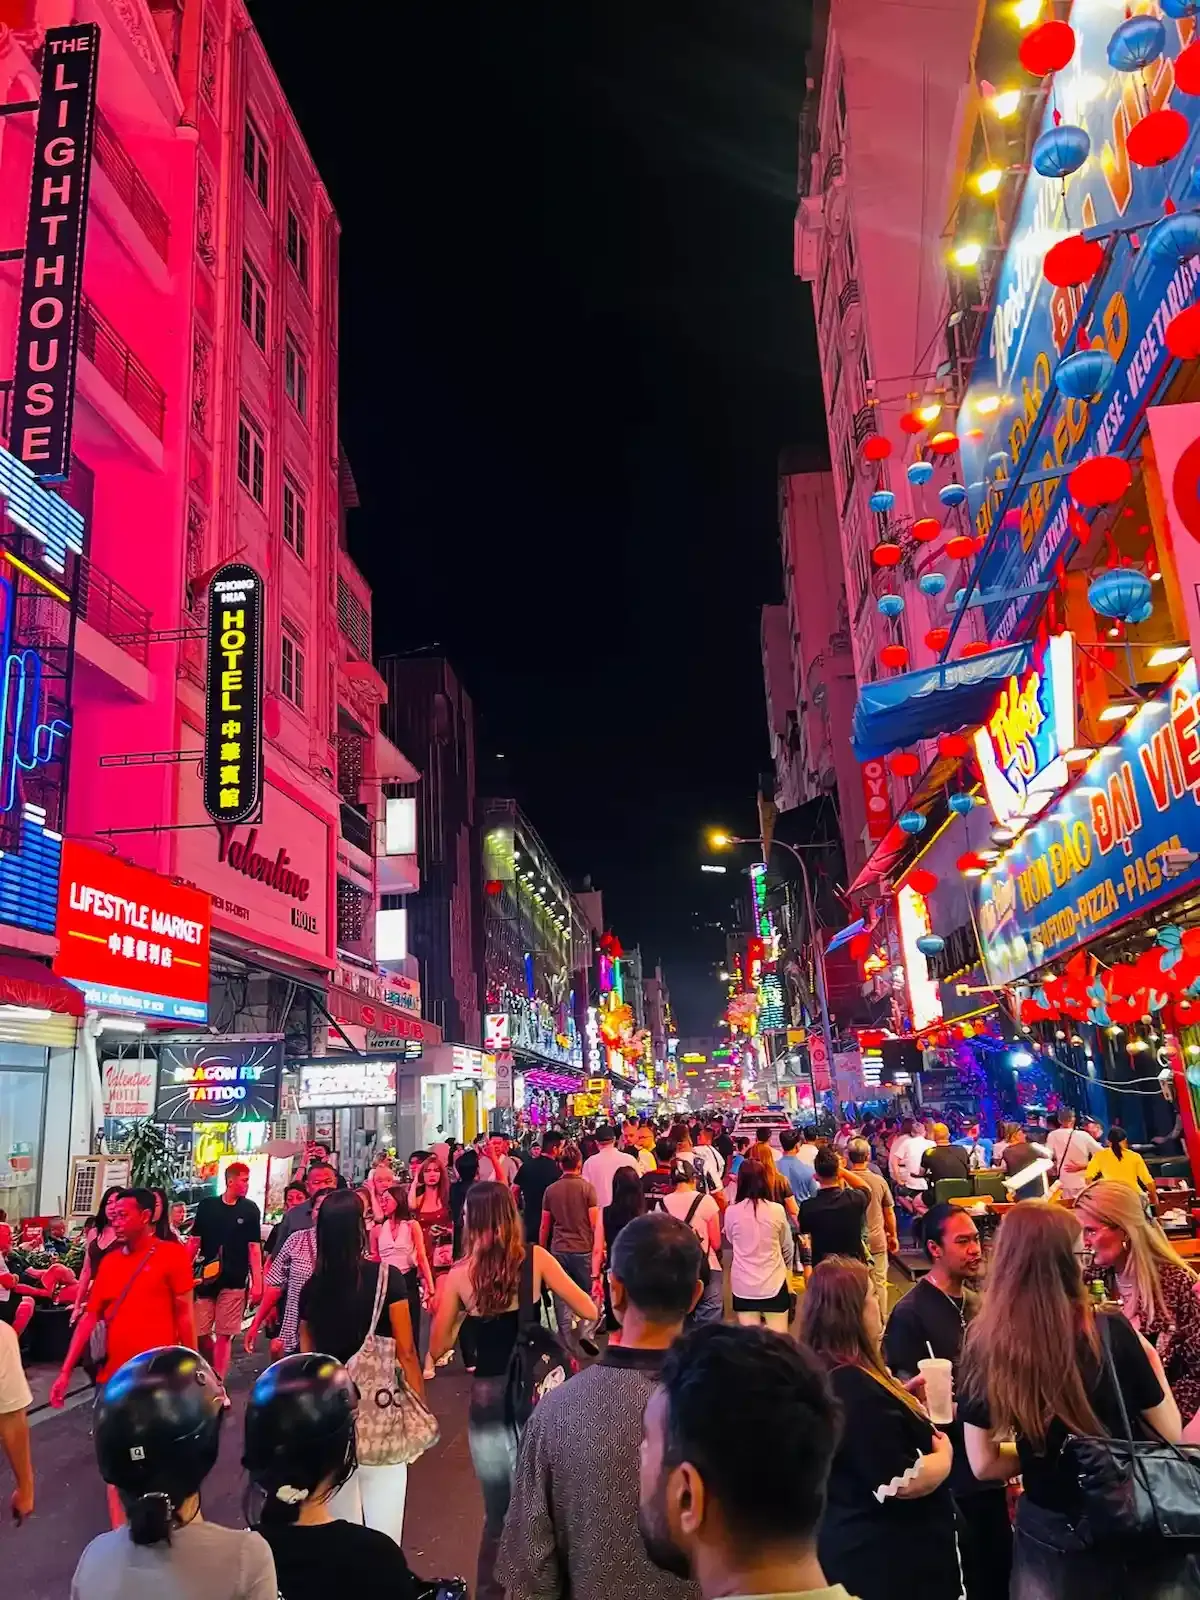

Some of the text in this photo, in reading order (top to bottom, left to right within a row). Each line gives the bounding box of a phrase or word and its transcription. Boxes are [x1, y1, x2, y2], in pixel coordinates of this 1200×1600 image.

[50, 37, 89, 54] THE
[22, 63, 78, 461] LIGHTHOUSE
[214, 578, 255, 593] ZHONG
[220, 591, 247, 604] HUA
[220, 609, 246, 711] HOTEL
[1138, 685, 1200, 812] VIỆ
[865, 762, 887, 812] OYO
[69, 881, 204, 945] LIFESTYLE MARKET
[383, 1013, 424, 1040] PUB
[371, 1039, 401, 1048] HOTEL
[173, 1065, 265, 1082] DRAGON FLY
[187, 1086, 247, 1101] TATTOO
